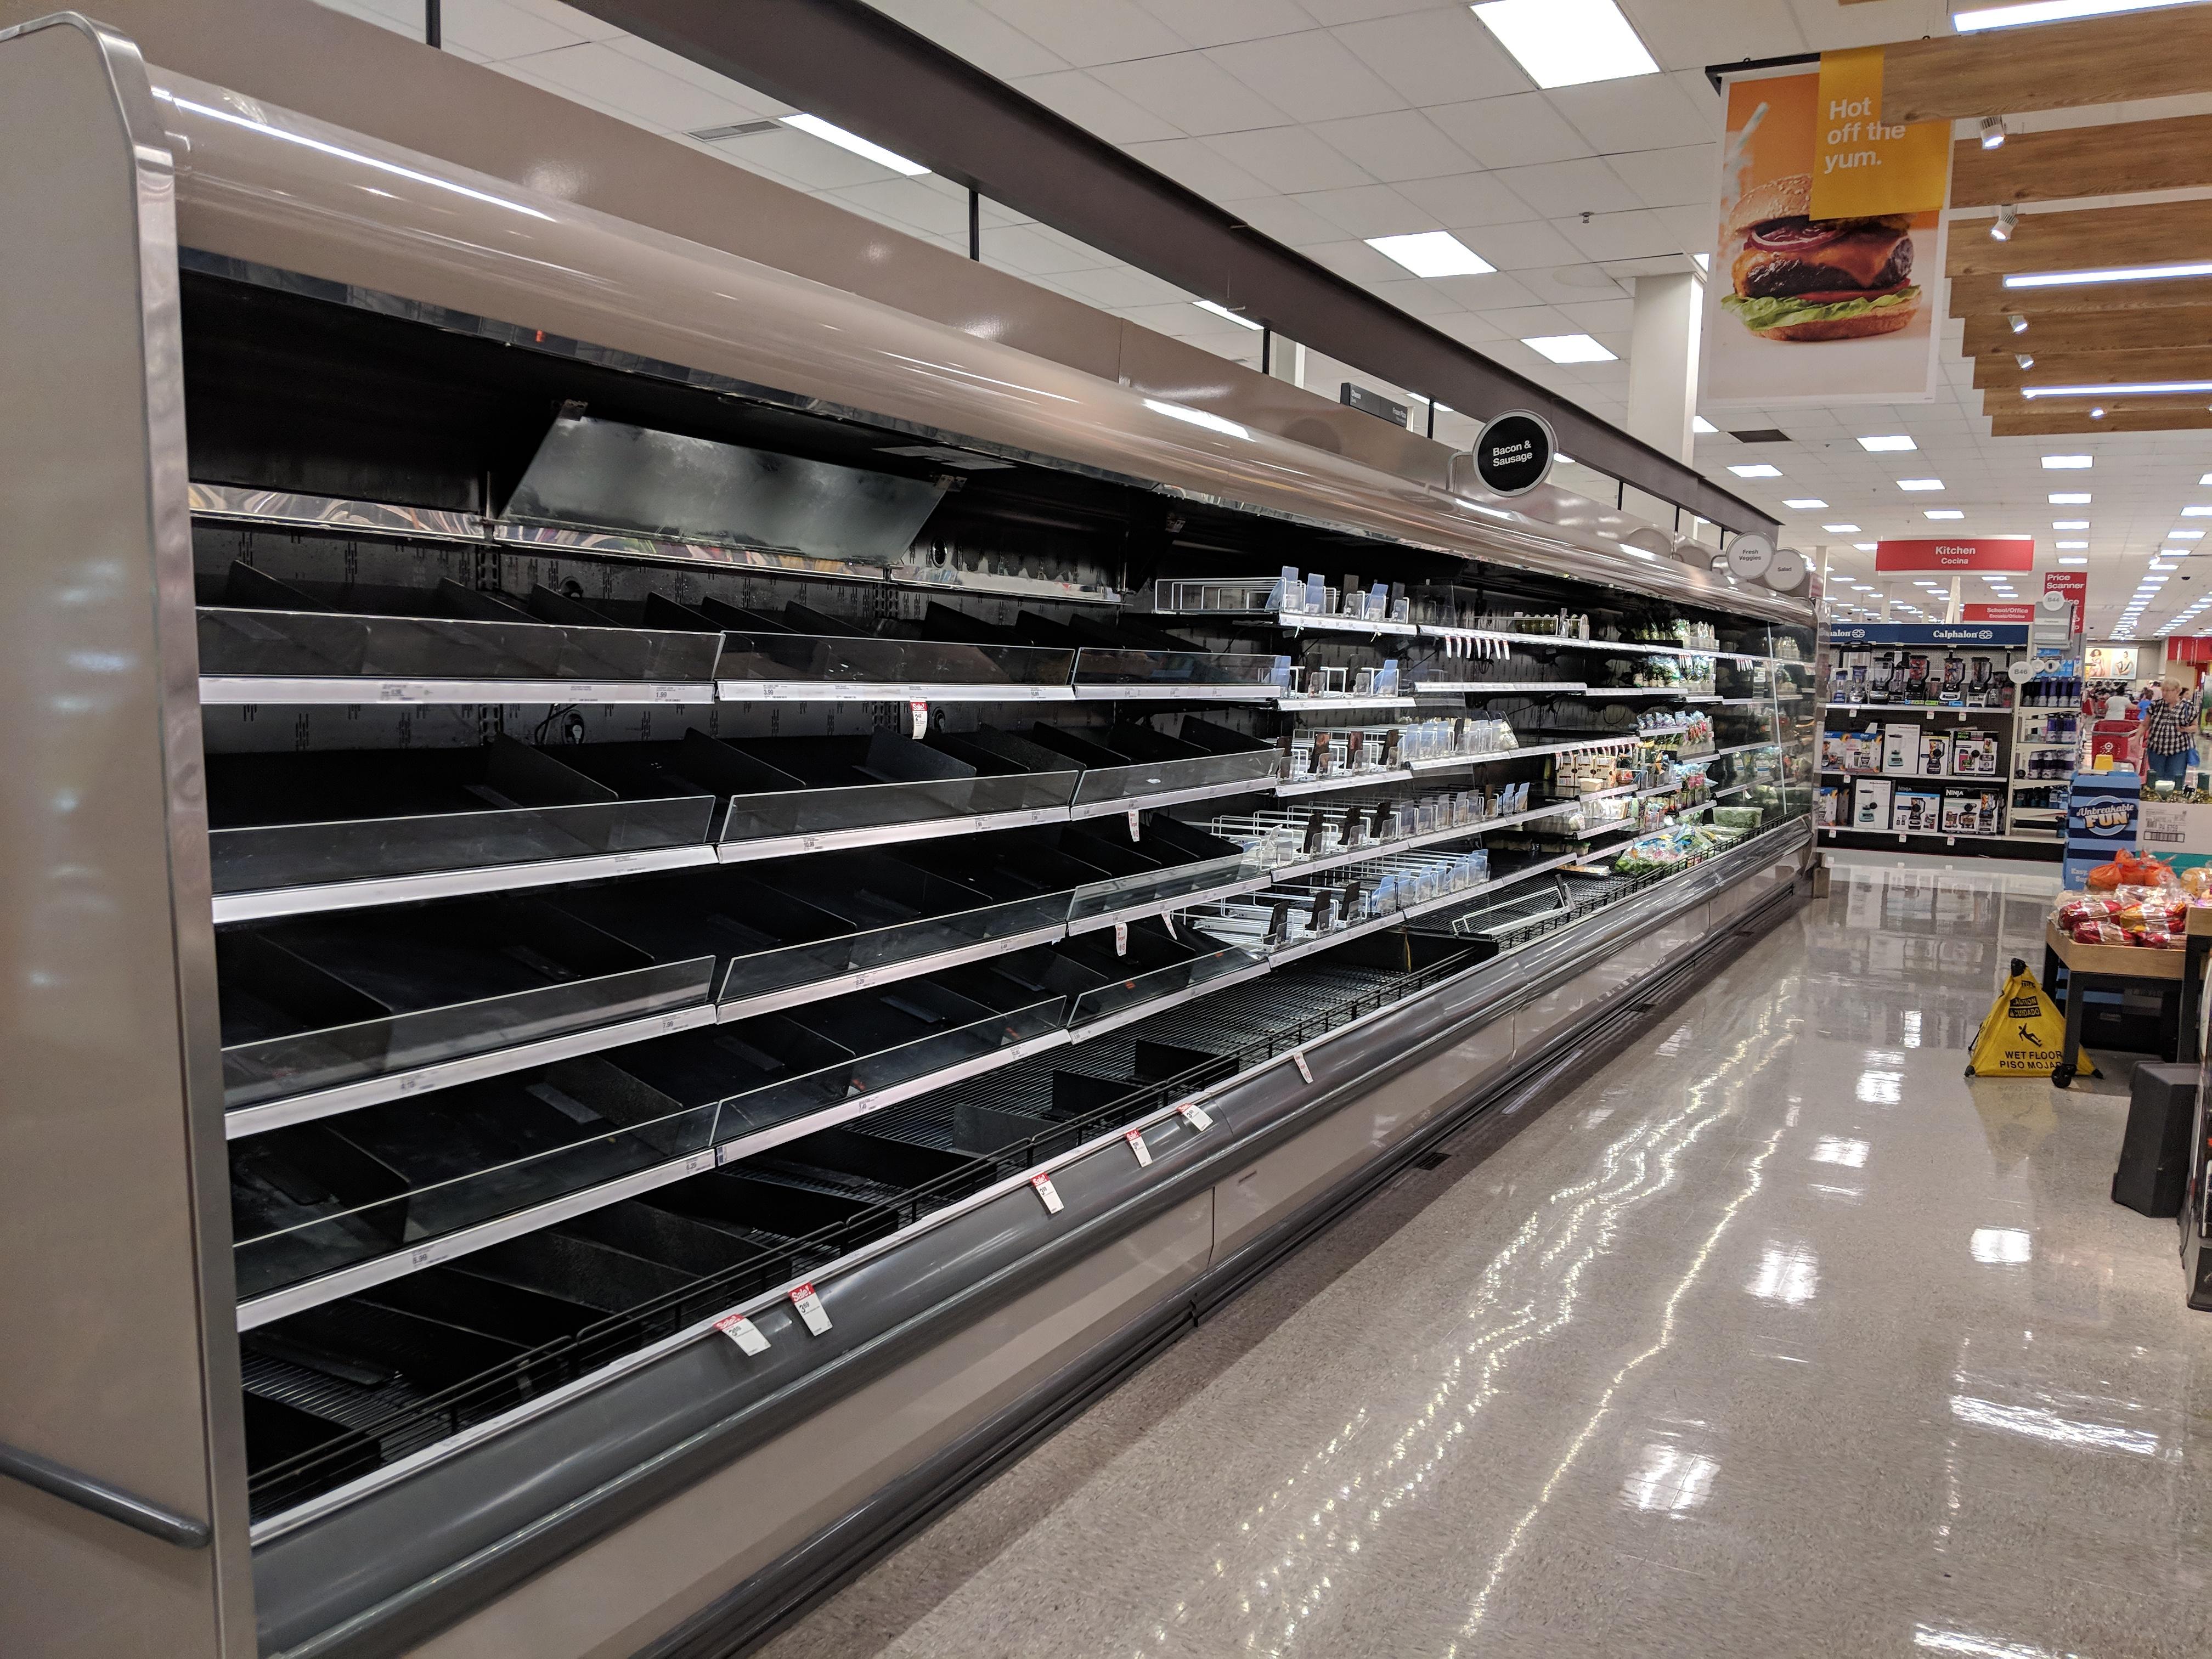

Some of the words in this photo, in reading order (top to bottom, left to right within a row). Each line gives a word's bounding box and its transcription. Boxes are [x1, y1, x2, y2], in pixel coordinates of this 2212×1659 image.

[1829, 97, 1872, 121] Hot
[1827, 122, 1860, 145] off
[1866, 121, 1906, 141] the
[1824, 150, 1882, 174] yum.
[1493, 443, 1522, 456] Bacon
[1524, 440, 1532, 449] &
[1493, 452, 1533, 467] Sausage
[1935, 546, 1976, 555] Kitchen
[1933, 630, 1978, 639] Calphalon
[1945, 789, 1964, 797] NINJA
[2076, 804, 2134, 816] Unbreakable
[2085, 811, 2128, 828] FUN
[2013, 997, 2037, 1006] AUTION
[2029, 1051, 2063, 1059] FLOOR
[2000, 1060, 2024, 1069] PISO
[1126, 1130, 1138, 1140] Sale!
[1033, 1174, 1046, 1186] Sale!
[791, 1285, 811, 1301] Sale!
